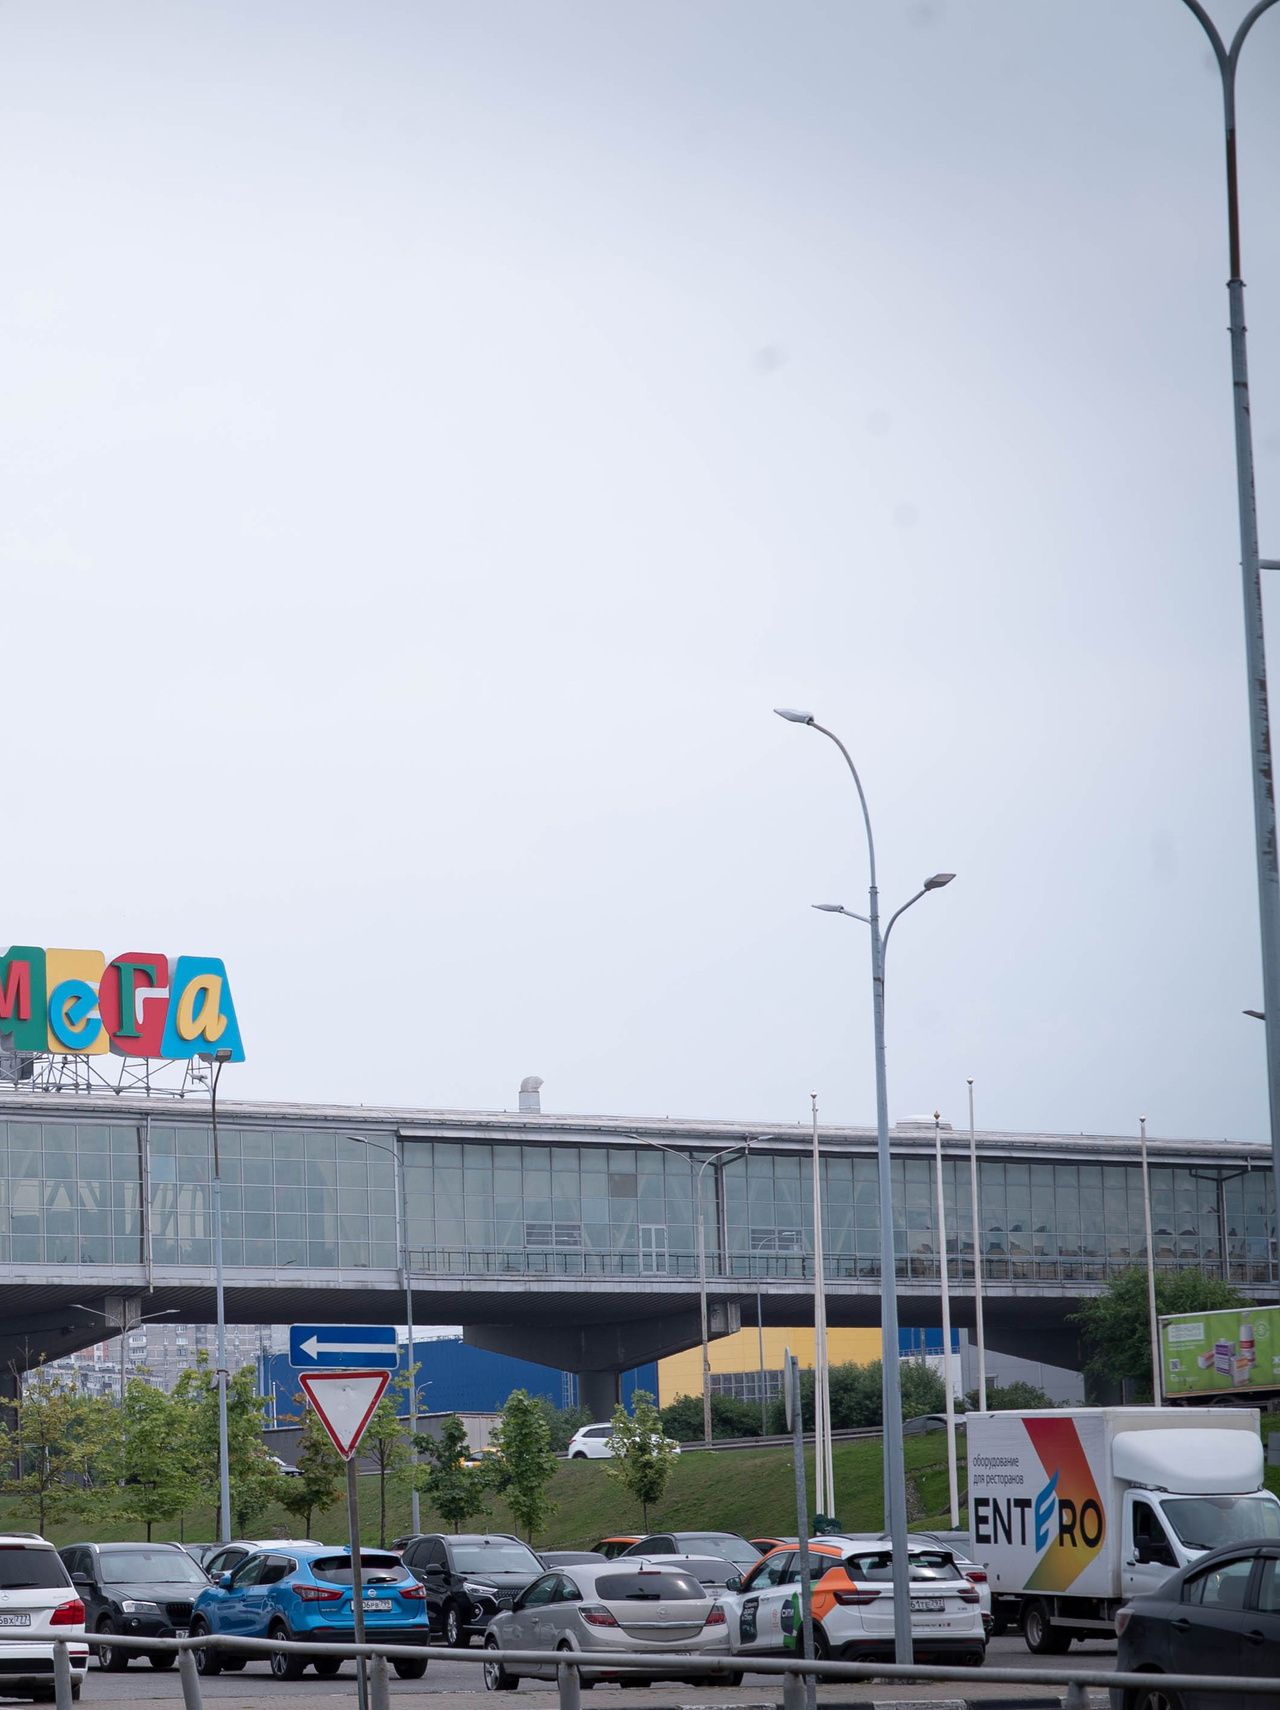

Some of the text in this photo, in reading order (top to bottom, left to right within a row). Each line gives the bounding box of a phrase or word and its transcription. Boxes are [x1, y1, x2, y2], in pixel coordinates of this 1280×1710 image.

[973, 1454, 1019, 1470] оборудование
[973, 1474, 1024, 1487] для ресторанов
[974, 1467, 1103, 1554] ENTERO
